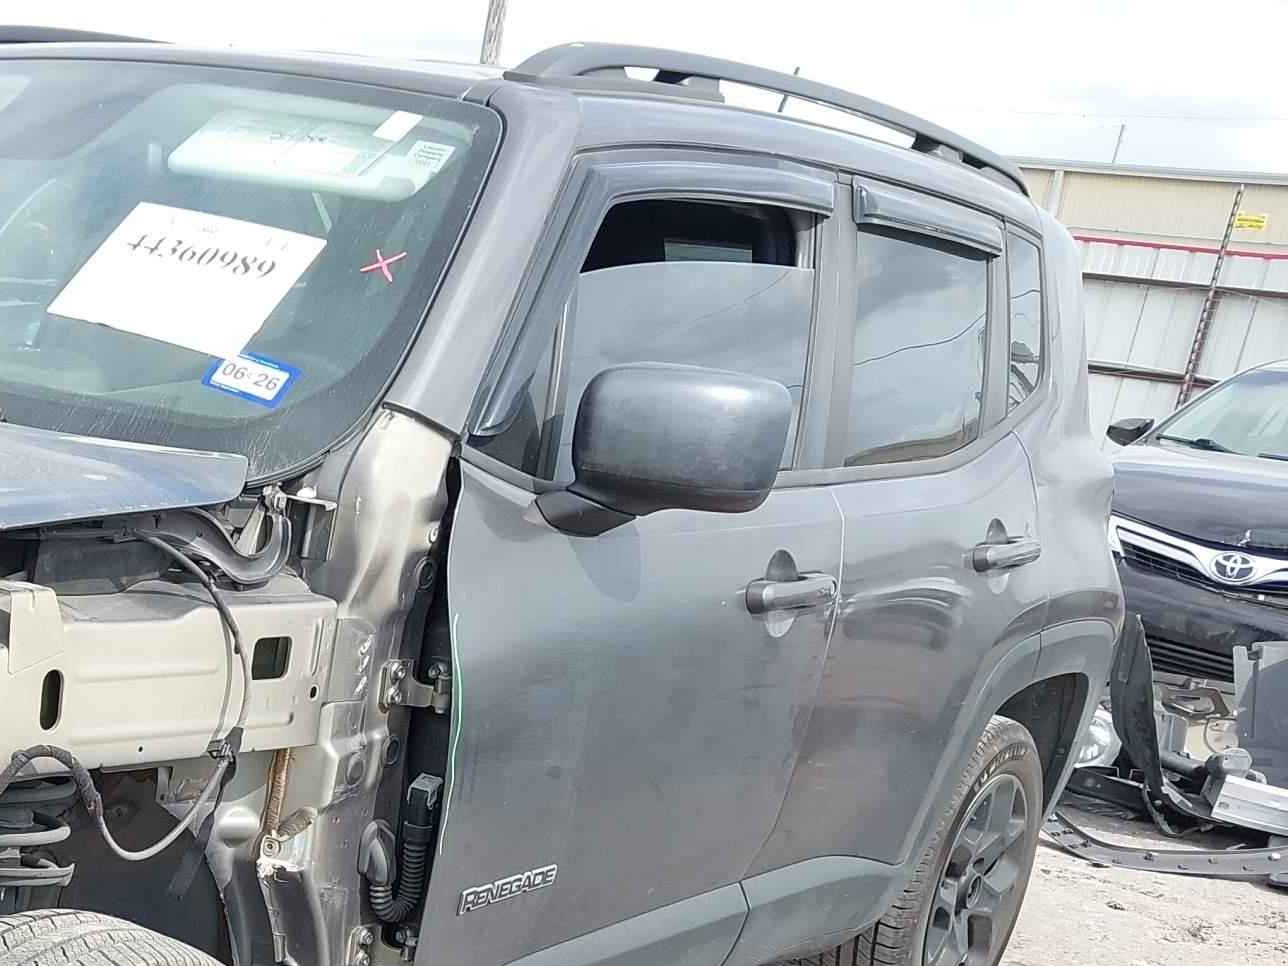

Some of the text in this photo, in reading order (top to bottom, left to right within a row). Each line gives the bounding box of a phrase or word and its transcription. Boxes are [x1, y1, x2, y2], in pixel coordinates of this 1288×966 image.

[127, 233, 277, 279] 44360989
[222, 362, 248, 380] 06
[253, 373, 280, 391] 26
[456, 863, 558, 917] RENEGADE
